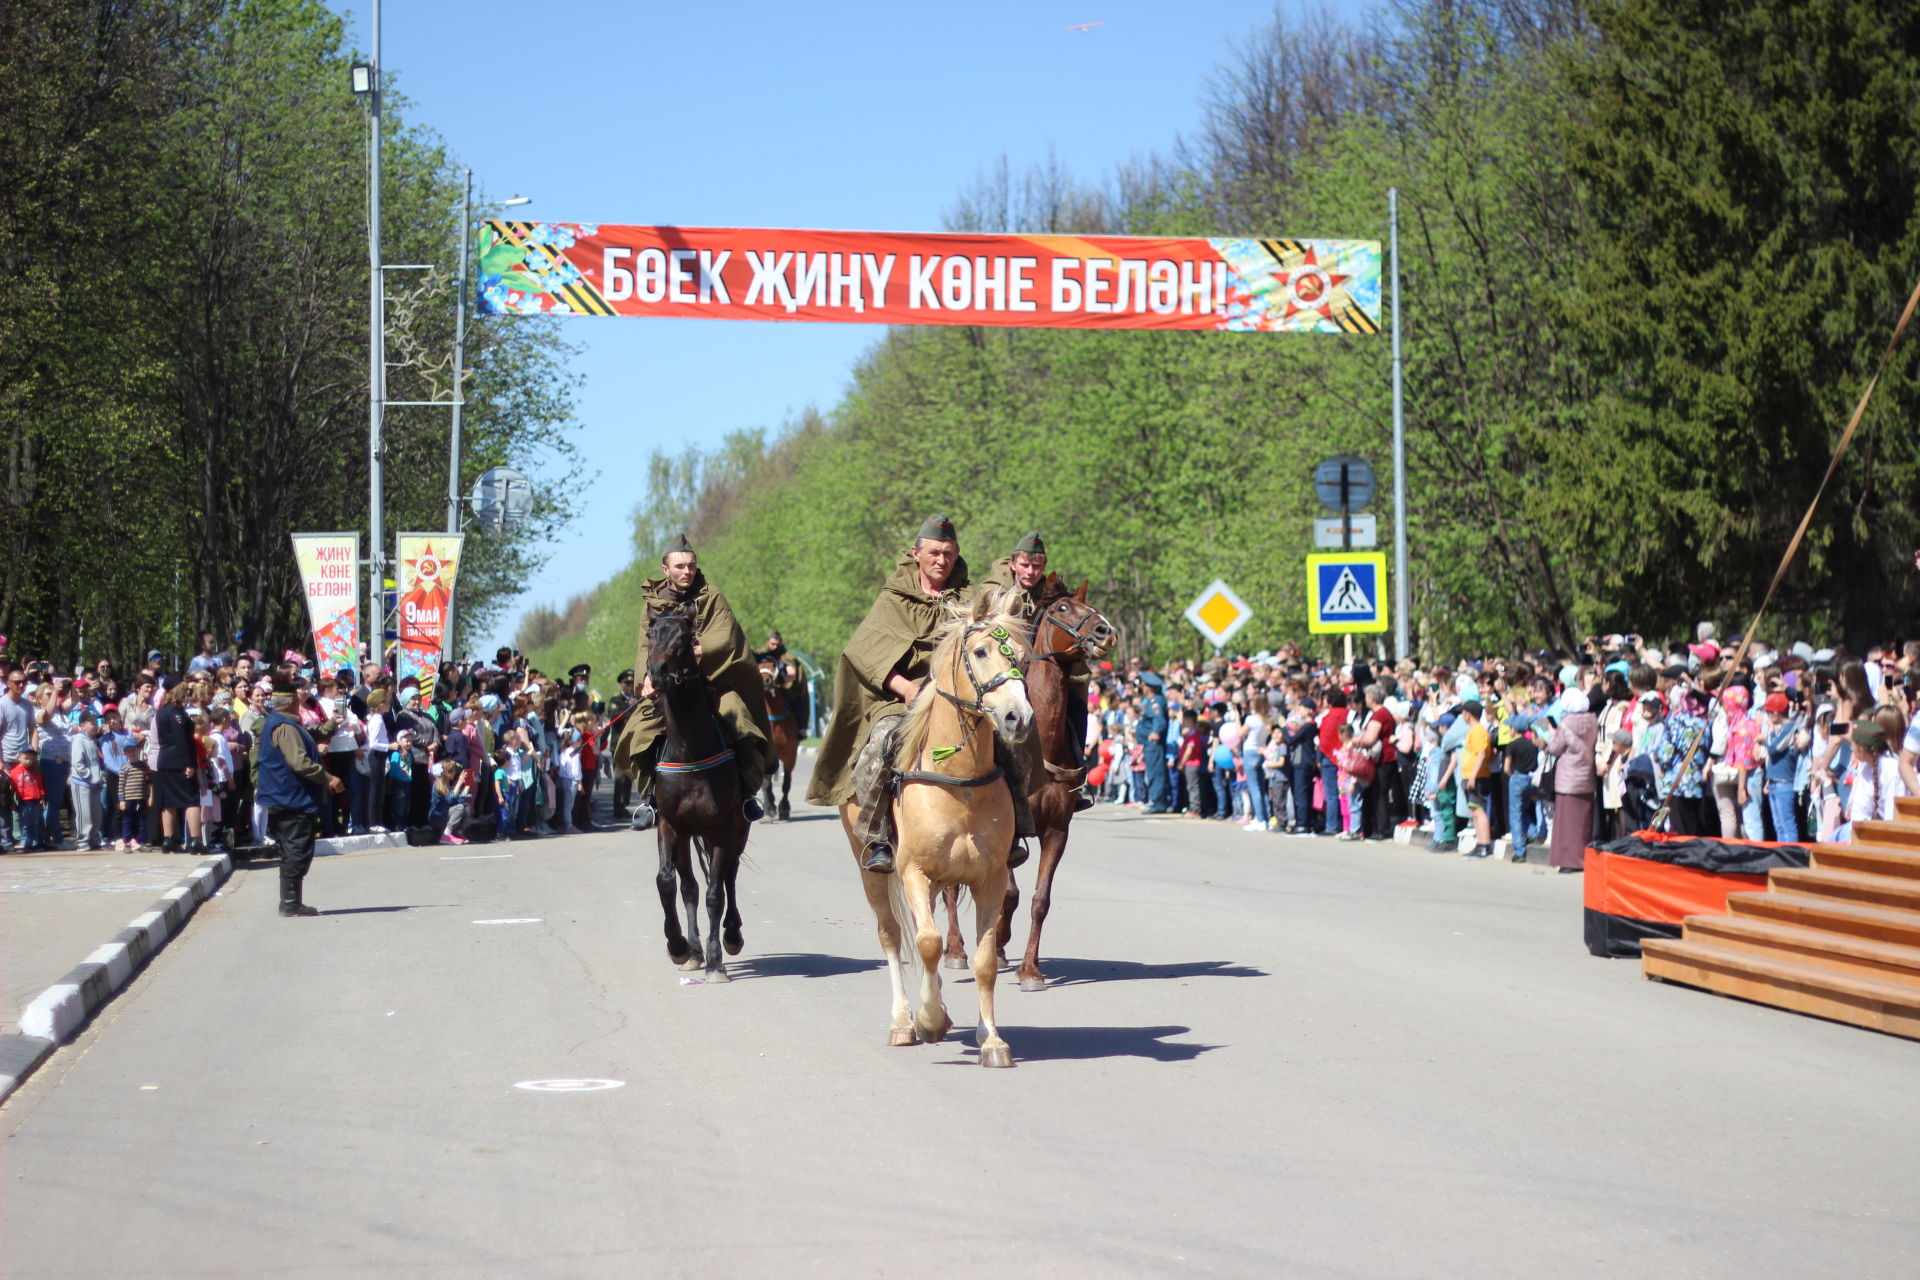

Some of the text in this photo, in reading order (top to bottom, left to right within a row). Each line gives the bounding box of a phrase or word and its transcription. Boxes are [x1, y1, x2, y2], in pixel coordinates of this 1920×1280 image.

[603, 247, 731, 304] БӨЕК
[744, 250, 897, 313] ҖИҢҮ
[910, 254, 1037, 312] КӨНЕ
[1051, 258, 1228, 315] БЕЛӘН!
[321, 564, 352, 579] КӨНЕ
[309, 582, 352, 597] БЕЛӘН!
